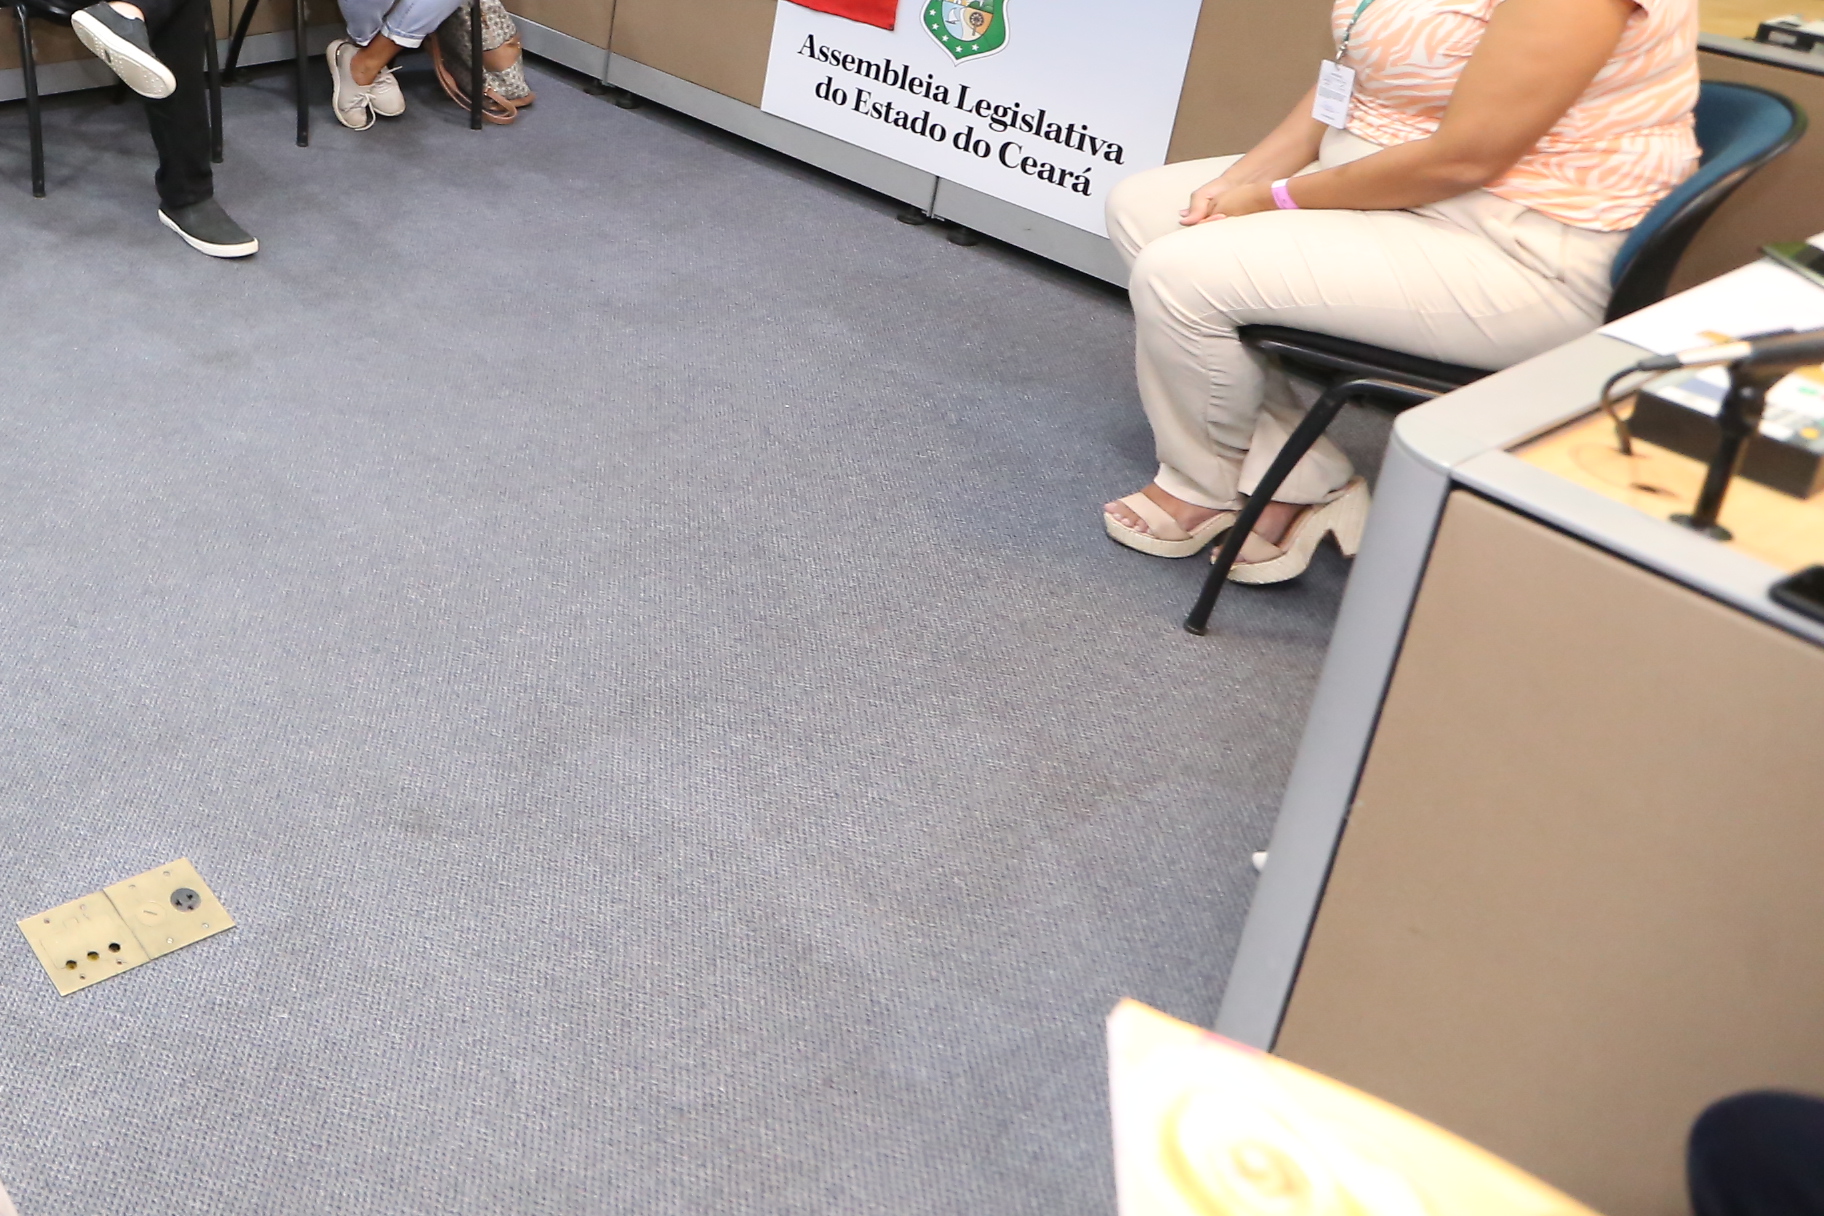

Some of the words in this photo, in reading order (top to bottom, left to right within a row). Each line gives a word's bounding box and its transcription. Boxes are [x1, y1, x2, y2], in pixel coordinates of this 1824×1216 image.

[798, 33, 950, 105] Assembleia
[956, 85, 1125, 165] Legislativa
[815, 76, 848, 105] do
[852, 89, 946, 143] Estado
[953, 119, 991, 159] do
[998, 141, 1093, 197] Ceará
